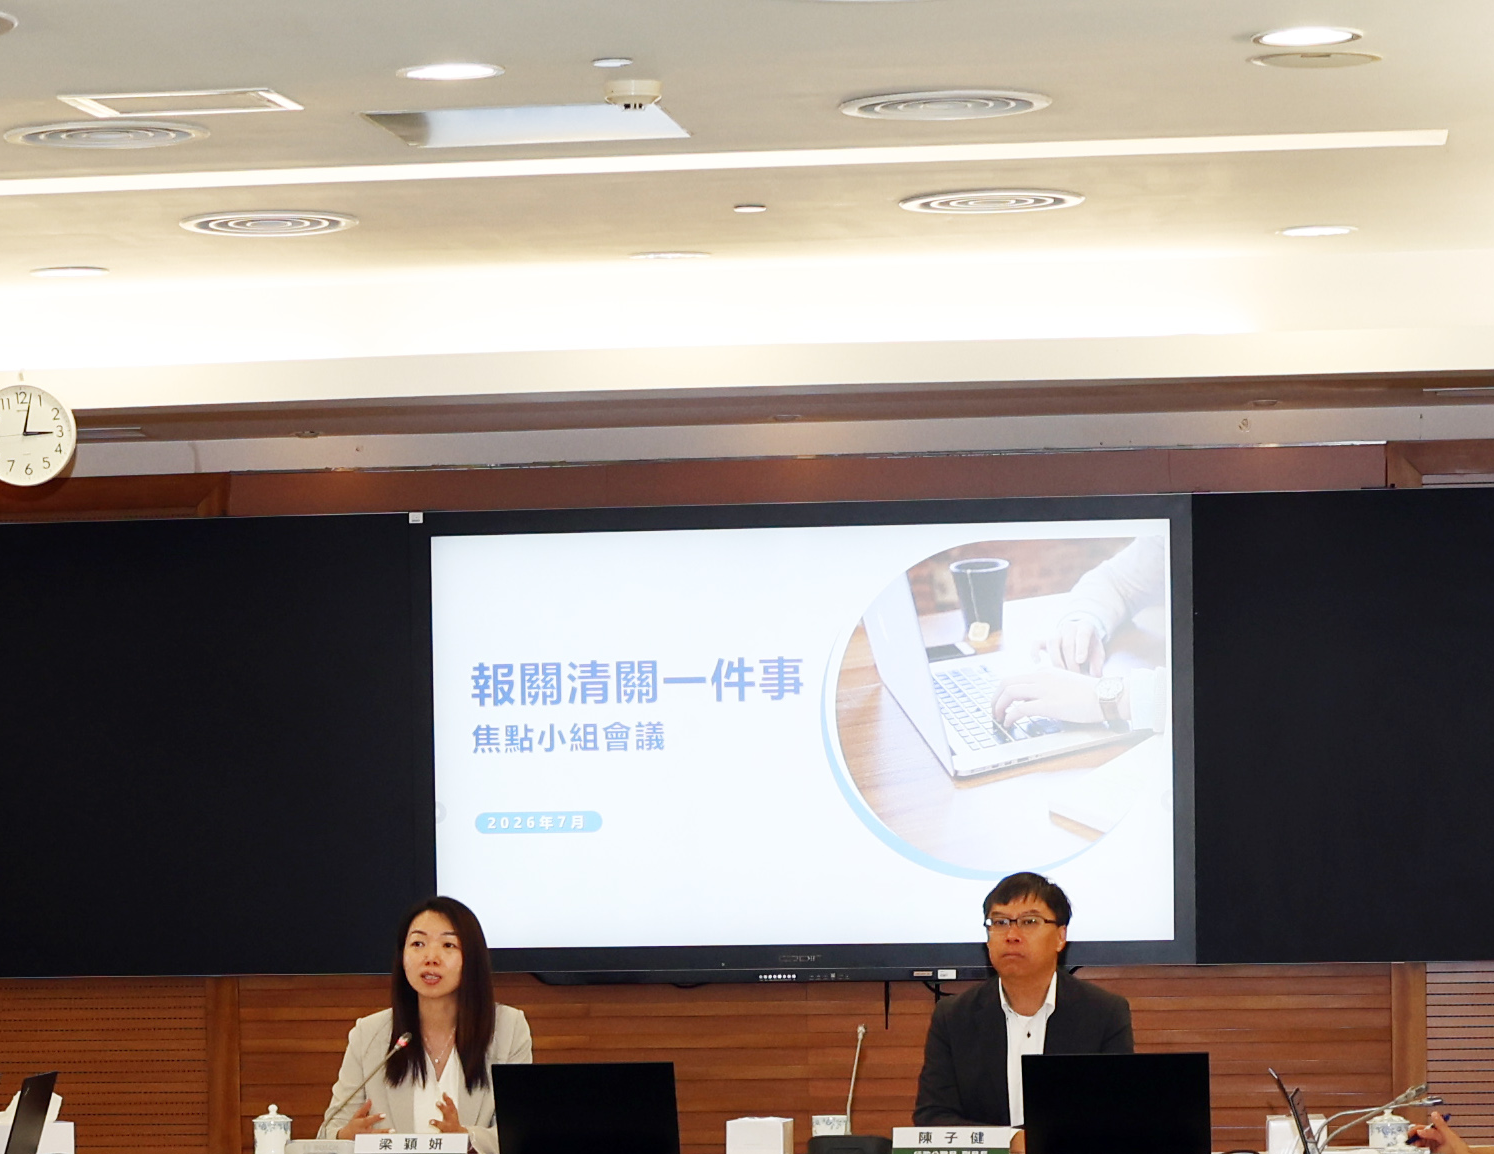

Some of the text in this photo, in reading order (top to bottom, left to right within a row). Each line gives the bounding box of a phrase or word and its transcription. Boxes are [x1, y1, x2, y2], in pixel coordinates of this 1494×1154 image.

[0, 397, 11, 410] 11
[15, 391, 28, 404] 12
[38, 394, 42, 407] 1
[51, 407, 60, 420] 2
[56, 425, 64, 438] 3
[54, 443, 62, 454] 4
[7, 460, 15, 472] 7
[24, 463, 33, 475] 6
[42, 456, 51, 469] 5
[471, 656, 804, 707] 報關清關一件事
[472, 721, 665, 753] 焦點小組會議
[487, 815, 585, 830] 2026年7月
[918, 1131, 985, 1144] 陳子健
